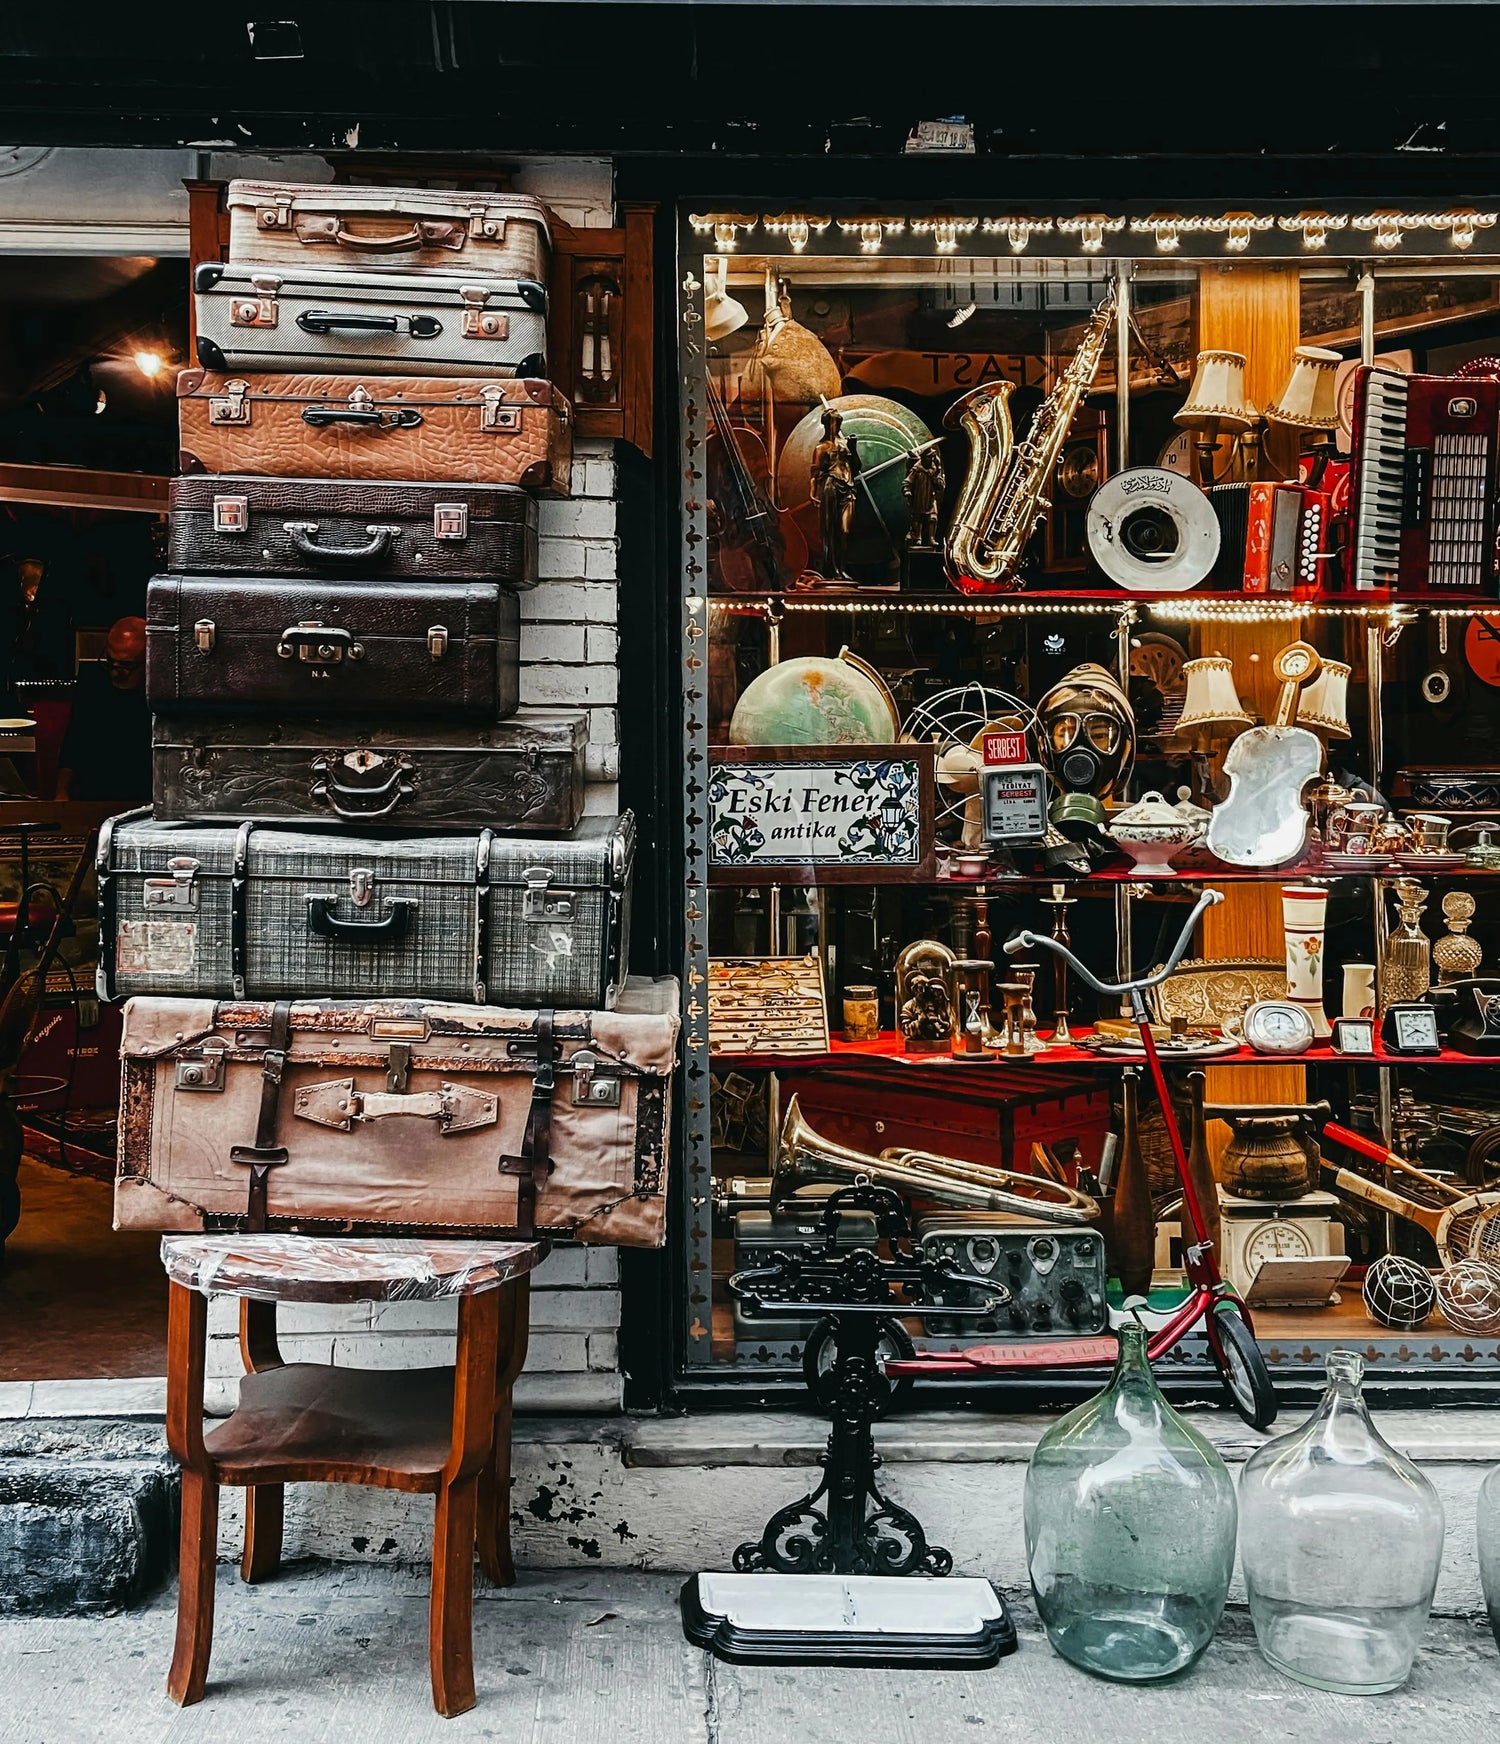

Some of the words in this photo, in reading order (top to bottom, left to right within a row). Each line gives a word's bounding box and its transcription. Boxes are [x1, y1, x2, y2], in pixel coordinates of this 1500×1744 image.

[987, 737, 1021, 760] SERBEST
[728, 788, 793, 813] Eski
[801, 788, 880, 813] Fener
[771, 820, 837, 840] antika
